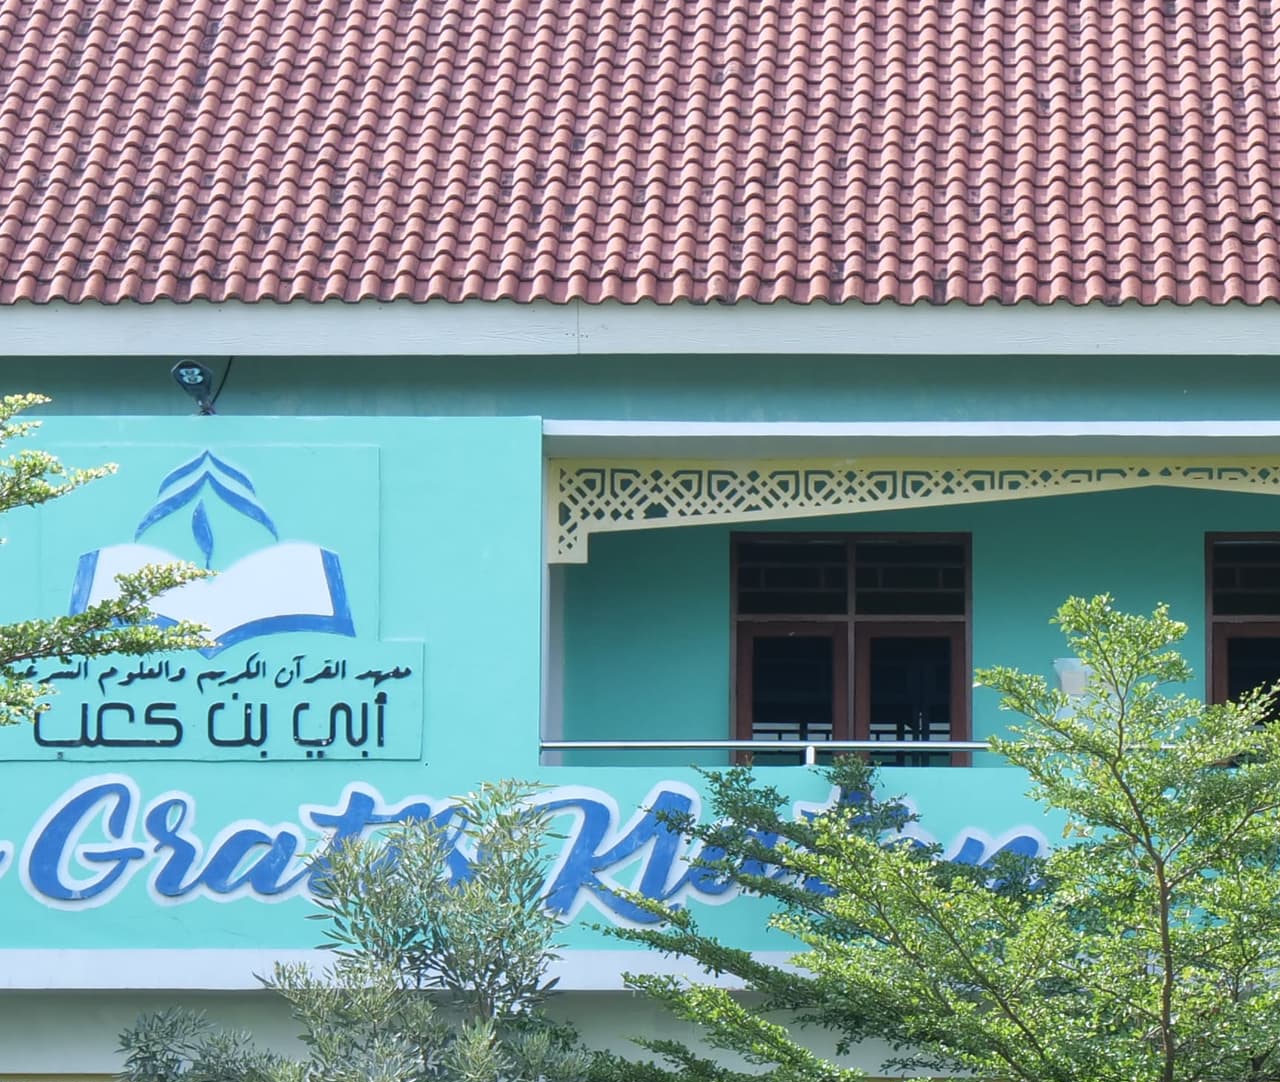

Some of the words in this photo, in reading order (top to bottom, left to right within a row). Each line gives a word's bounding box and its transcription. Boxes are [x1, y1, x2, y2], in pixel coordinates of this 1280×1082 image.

[196, 652, 267, 694] الكريم
[274, 655, 347, 688] القرآن
[354, 665, 412, 688] معهد
[520, 788, 1065, 923] Klatn
